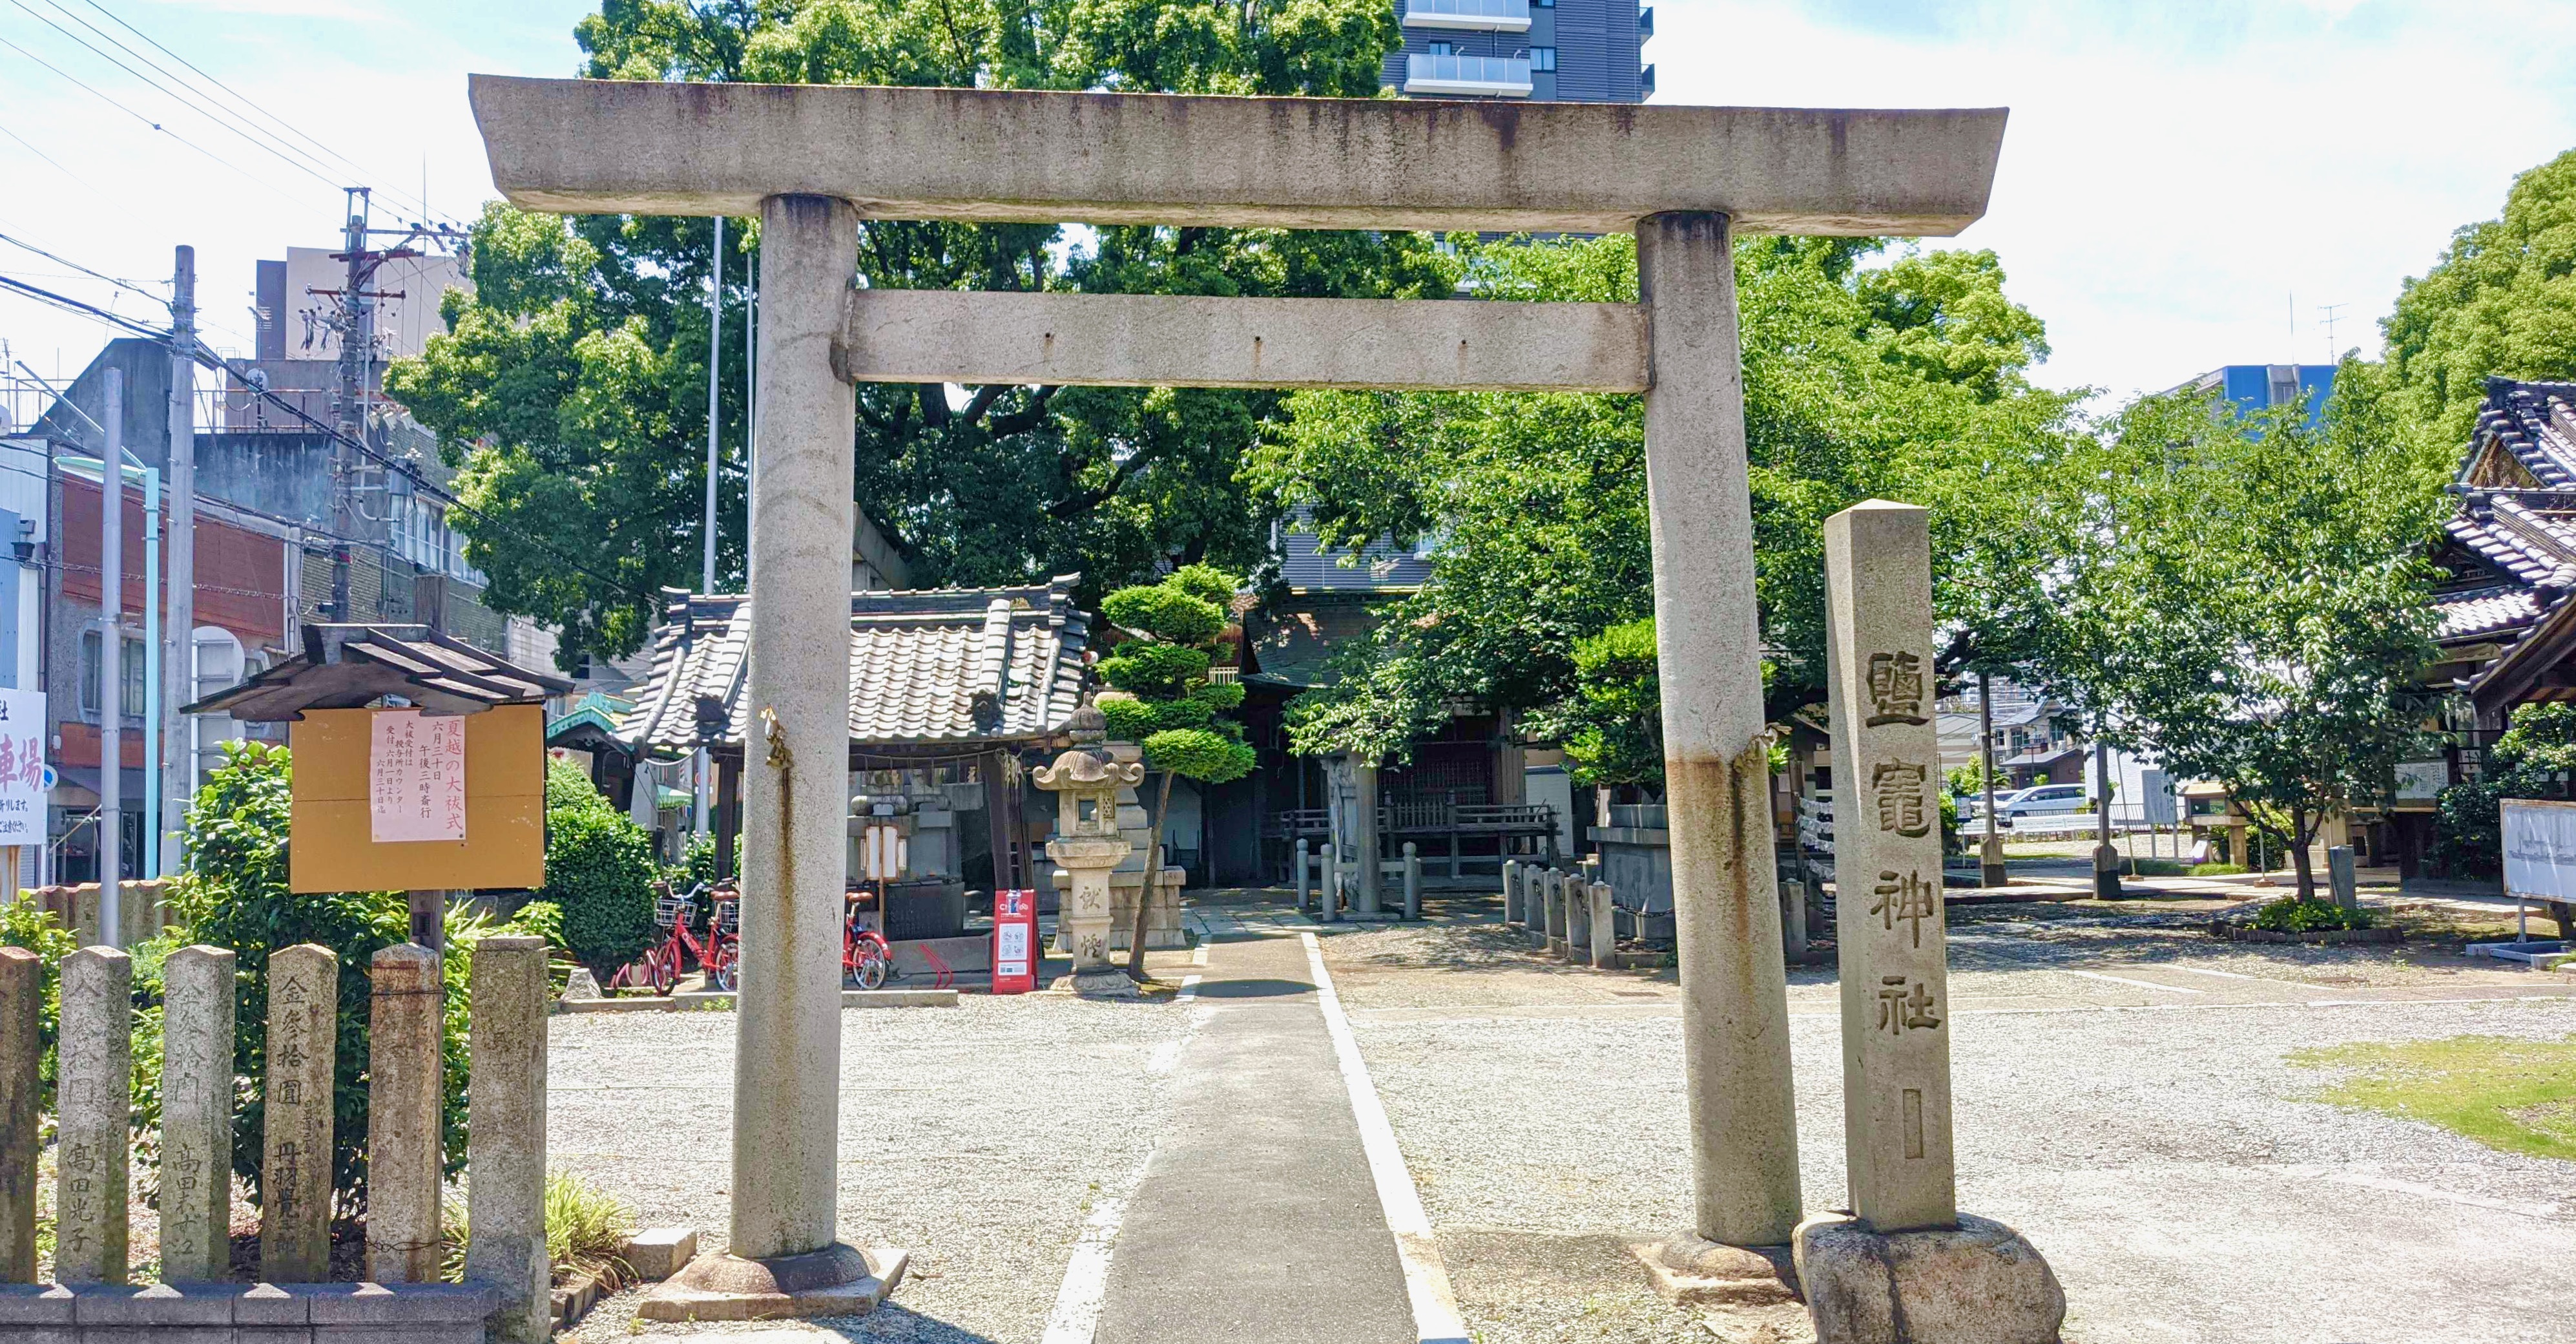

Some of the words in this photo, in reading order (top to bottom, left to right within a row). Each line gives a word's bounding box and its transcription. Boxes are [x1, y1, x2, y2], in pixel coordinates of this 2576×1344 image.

[386, 726, 395, 744] 受付
[404, 720, 415, 766] 大祓受付は
[431, 721, 444, 781] 六月三十日
[375, 759, 386, 814] 六月三十日迄
[385, 750, 396, 804] 六月一日より
[395, 739, 405, 814] 授与所カウンター
[419, 744, 432, 819] 午後三時斎行
[445, 719, 463, 830] 夏越の大祓式
